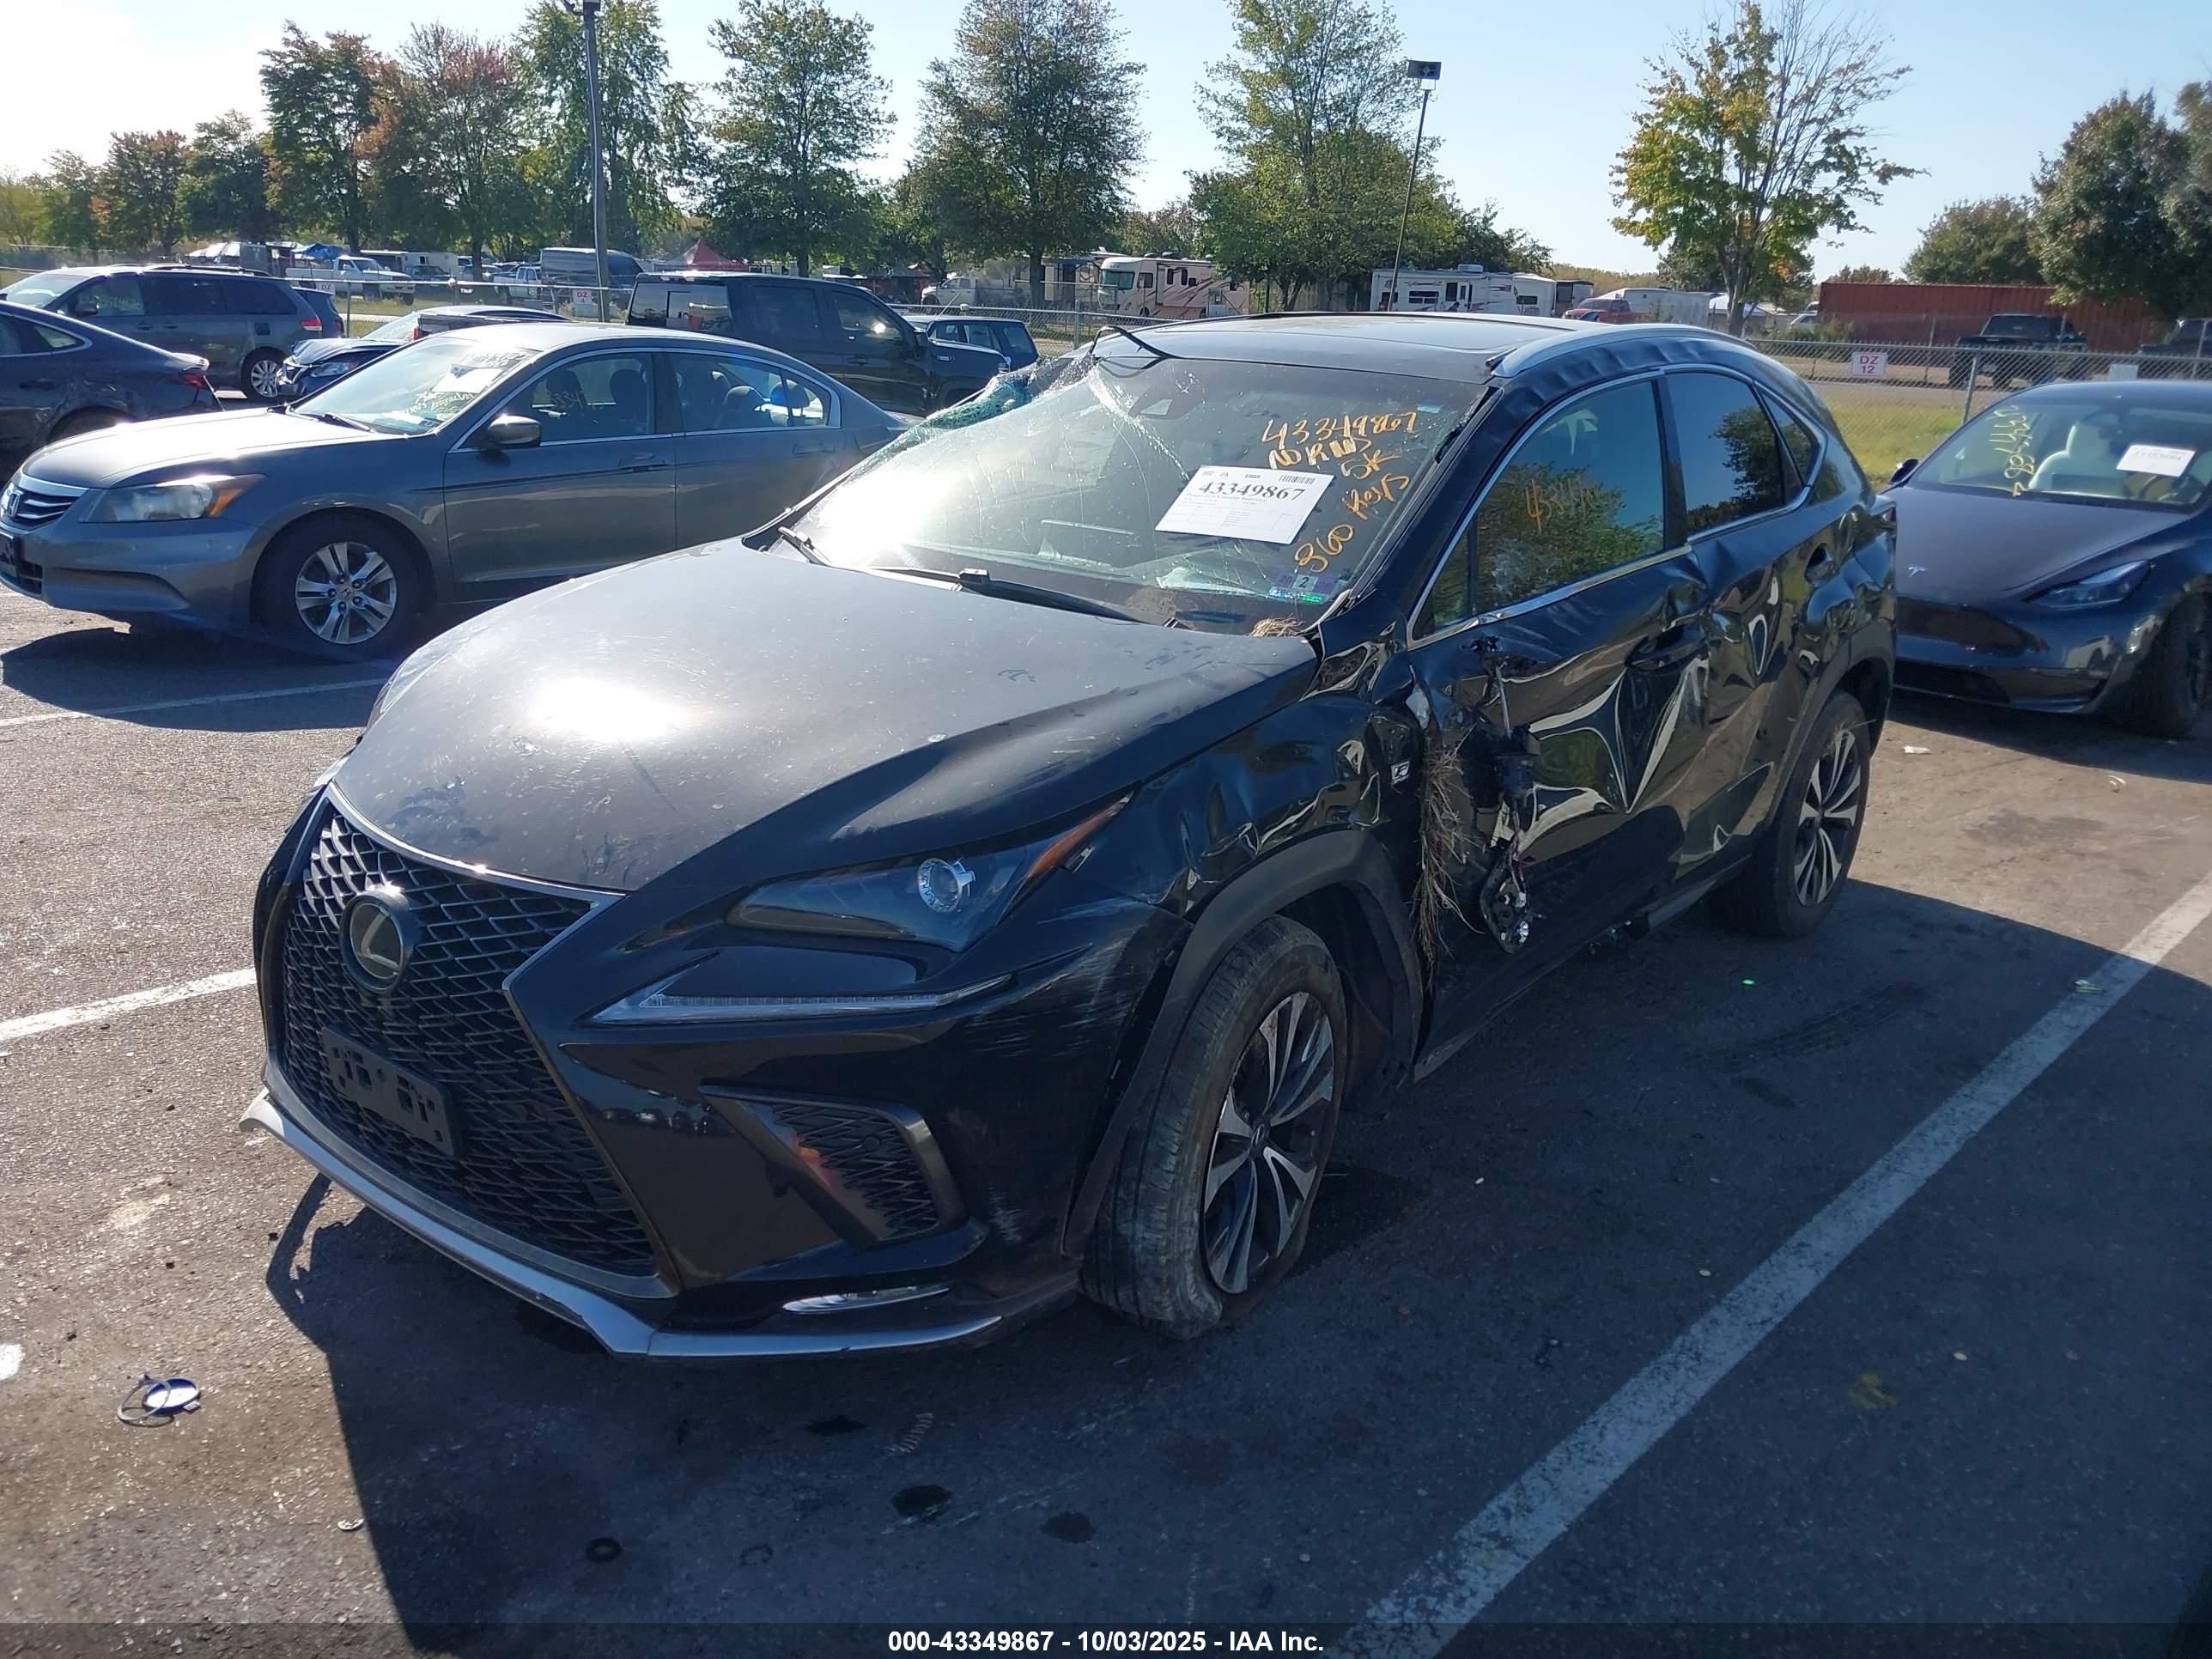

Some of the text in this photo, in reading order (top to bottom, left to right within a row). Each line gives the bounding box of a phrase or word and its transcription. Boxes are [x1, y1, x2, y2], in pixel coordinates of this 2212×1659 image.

[1859, 356, 1879, 365] DZ
[1861, 365, 1875, 374] 12
[1199, 481, 1305, 501] 43349867
[1298, 576, 1310, 588] 2
